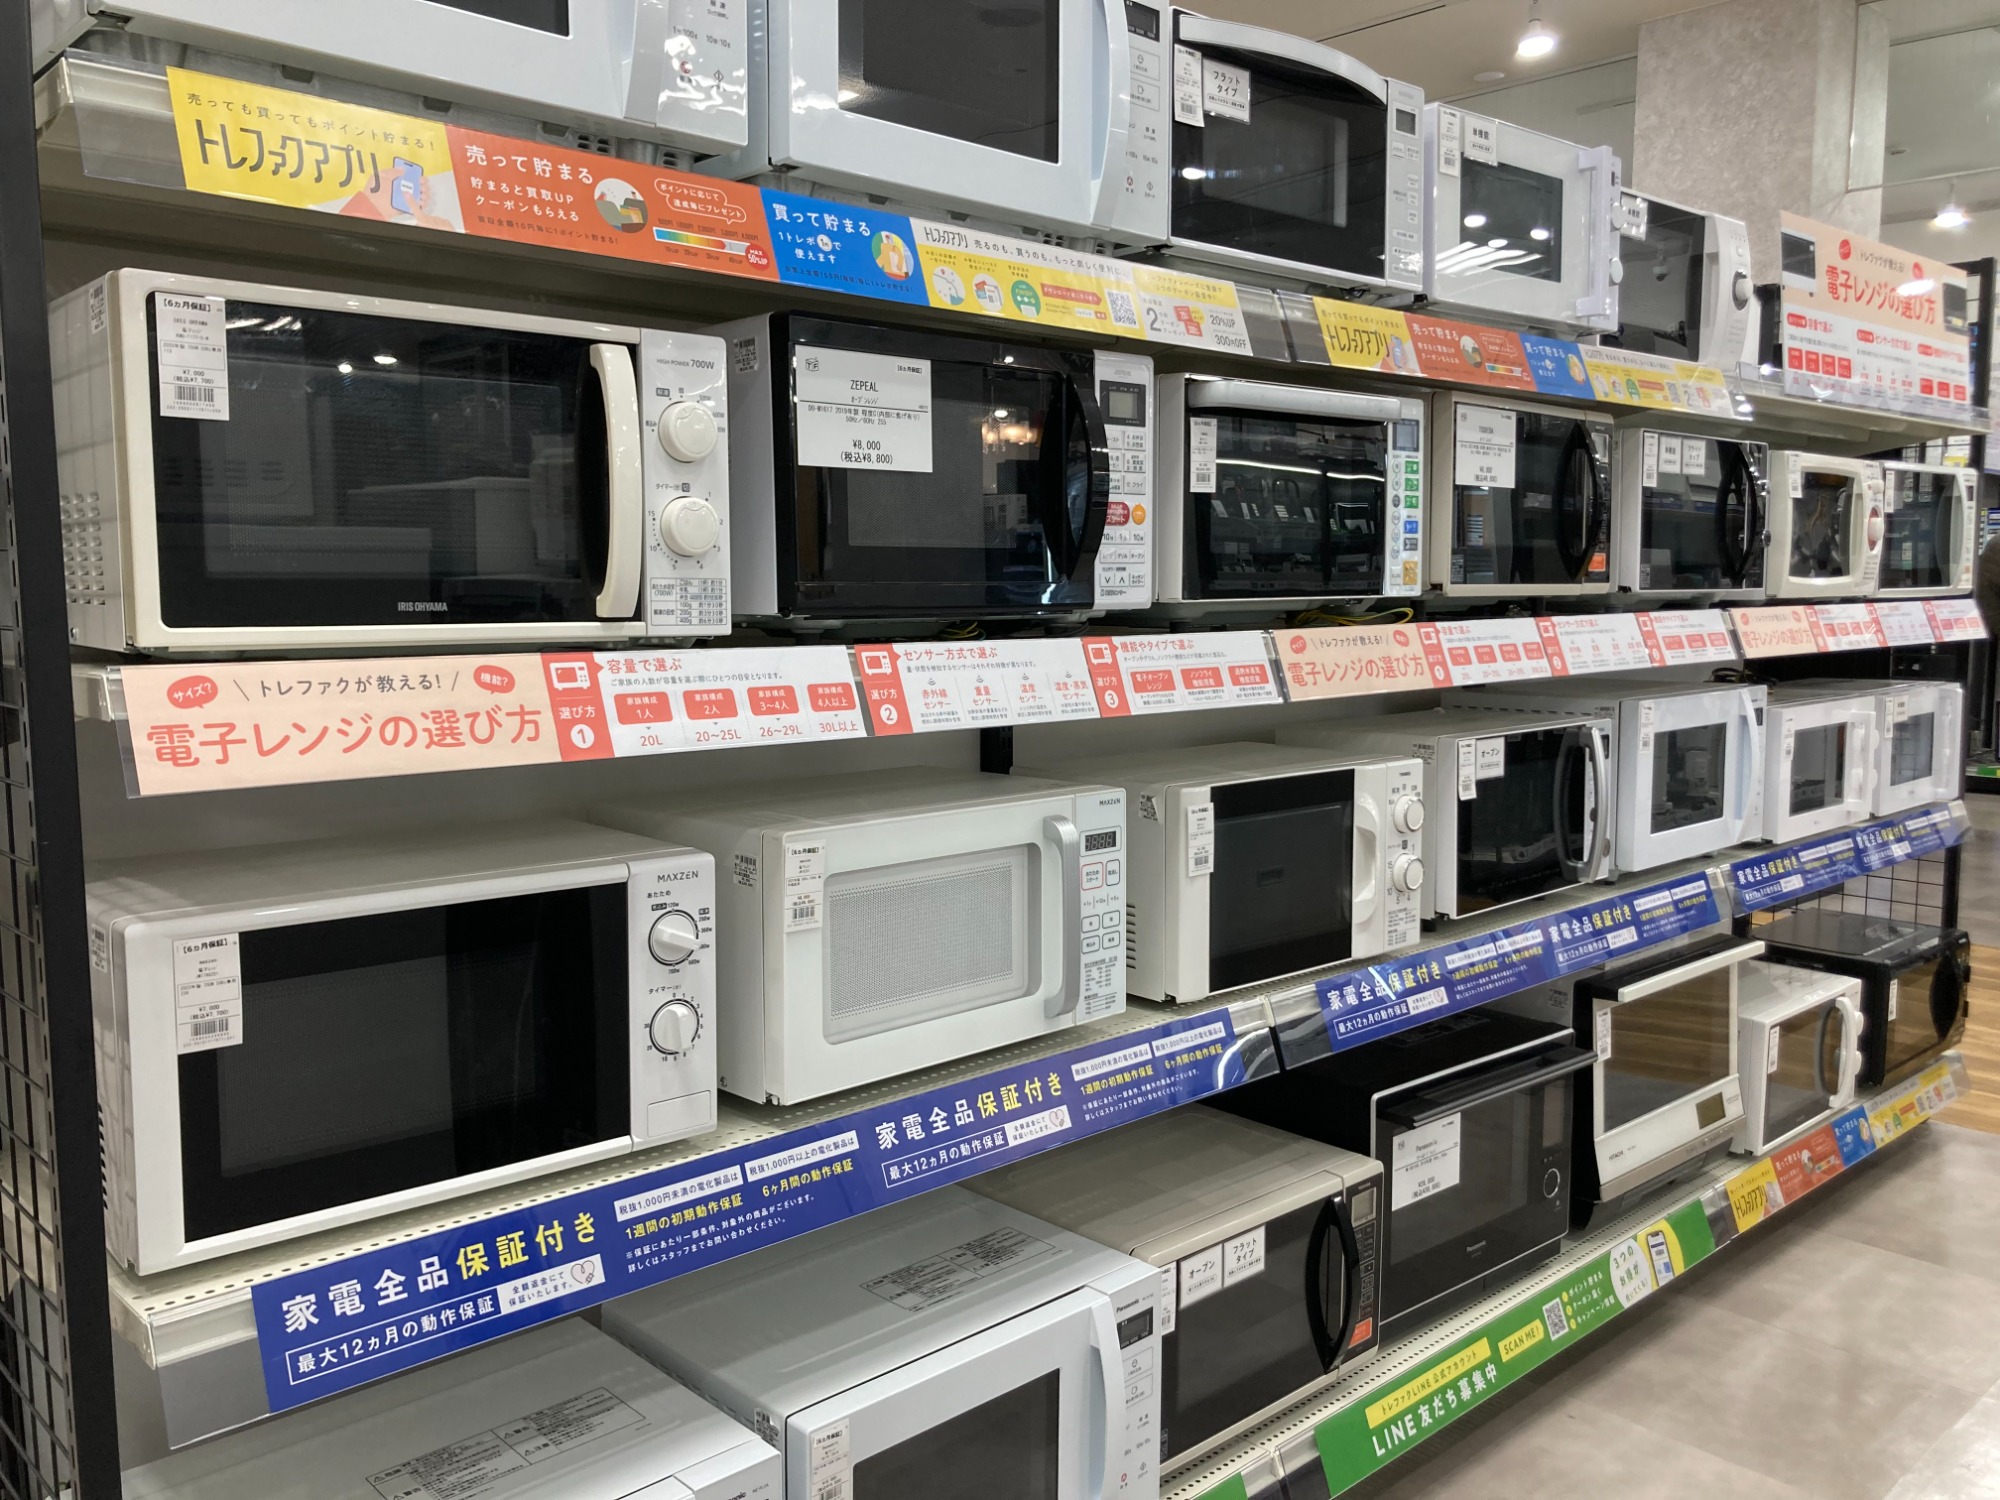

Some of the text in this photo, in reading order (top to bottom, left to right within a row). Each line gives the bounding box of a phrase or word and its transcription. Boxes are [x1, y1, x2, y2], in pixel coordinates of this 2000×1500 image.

[1217, 84, 1237, 97] タイプ
[195, 119, 381, 193] トレファクアプリ
[465, 145, 594, 185] 売って貯まる
[471, 176, 574, 204] 貯まると買取UP
[475, 194, 579, 222] クーポンもらえる
[772, 202, 871, 237] 買って貯まる
[924, 226, 968, 249] トレファクアプリ
[795, 248, 836, 265] 使えます
[1147, 307, 1162, 332] 2
[1327, 325, 1390, 357] トレファクアプリ
[1412, 323, 1459, 341] 売って貯まる
[690, 359, 715, 369] 700W
[850, 380, 879, 392] ZEPEAL
[853, 439, 881, 451] ¥8,000
[841, 452, 893, 464] (税込¥8,800)
[398, 602, 448, 611] IRIS OHYAMA
[1120, 639, 1194, 653] 機能やタイプで選ぶ
[1319, 635, 1383, 649] トレファクが教える!
[903, 646, 998, 661] センサー方式で選ぶ
[606, 656, 682, 674] 容量で選ぶ
[1190, 670, 1213, 678] ノンフライ
[1288, 653, 1425, 687] 電子レンジの選び方
[259, 673, 441, 697] トレファクが教える!
[480, 672, 508, 687] 機能?
[610, 672, 783, 687] ご家族の人数が容量を選ぶ際にひとつの目安となります。
[1096, 677, 1118, 687] 選び方
[1135, 673, 1169, 682] 電子オーブン
[1146, 682, 1163, 690] レンジ
[172, 681, 213, 703] サイズ?
[694, 691, 724, 701] 家族構成
[757, 687, 787, 698] 家族構成
[817, 685, 844, 695] 家族構成
[871, 689, 898, 700] 選び方
[922, 688, 948, 700] 赤外線
[974, 686, 991, 697] 重量
[1019, 694, 1043, 703] センサー
[1062, 691, 1086, 700] センサー
[626, 694, 658, 706] 家族構成
[704, 703, 721, 715] 2人
[817, 695, 849, 708] 4人以上
[924, 699, 951, 710] センサー
[972, 697, 999, 707] センサー
[558, 706, 596, 720] 選び方
[635, 707, 653, 720] 1人
[147, 703, 542, 768] 電子レンジの選び方
[818, 719, 859, 734] 30L以上
[639, 734, 664, 747] 20L
[1099, 798, 1121, 807] MAXZEN
[657, 870, 699, 883] MAXZEN
[647, 890, 672, 899] あたため
[1548, 904, 1632, 944] 家電全品保証付き
[1327, 961, 1442, 1011] 家電全品保証付き
[1338, 1003, 1409, 1033] 最大12ヵ月の動作保証
[1073, 1048, 1150, 1078] 税抜1,000円未満の電化製品は
[1164, 1044, 1224, 1070] 6ヶ月間の動作保証
[1080, 1064, 1154, 1096] 1週間の初期動作保証
[875, 1072, 1062, 1151] 家電全品保証付き
[1011, 1124, 1053, 1142] 保証いたします。
[749, 1137, 855, 1176] 税抜1,000円以上の電化製品は
[889, 1132, 1006, 1180] 最大12ヵ月の動作保証
[762, 1158, 854, 1198] 6ヶ月間の動作保証
[618, 1171, 739, 1216] 税抜1,000円未満の電化製品は
[1734, 1184, 1768, 1220] トレファクアプリ
[625, 1193, 744, 1240] 1週間の初期動作保証
[625, 1195, 815, 1260] ※保証にあたり一部条件、対象外の商品がございます。
[627, 1217, 786, 1274] 詳しくはスタッフまでお問い合わせください。
[1232, 1238, 1257, 1255] フラット
[1235, 1249, 1255, 1264] タイプ
[1613, 1245, 1634, 1269] 3つの
[281, 1211, 596, 1334] 家電全品保証付き
[1188, 1260, 1216, 1279] オーブン
[1620, 1260, 1639, 1287] お得が
[512, 1271, 565, 1296] 全額返金にて
[508, 1281, 573, 1307] 保証いたします。
[297, 1294, 496, 1376] 最大12ヵ月の動作保証
[1503, 1335, 1525, 1356] SCAN
[1381, 1350, 1477, 1416] トレファクLINE 公式アカウント
[1372, 1362, 1497, 1458] LINE 友だち募集中
